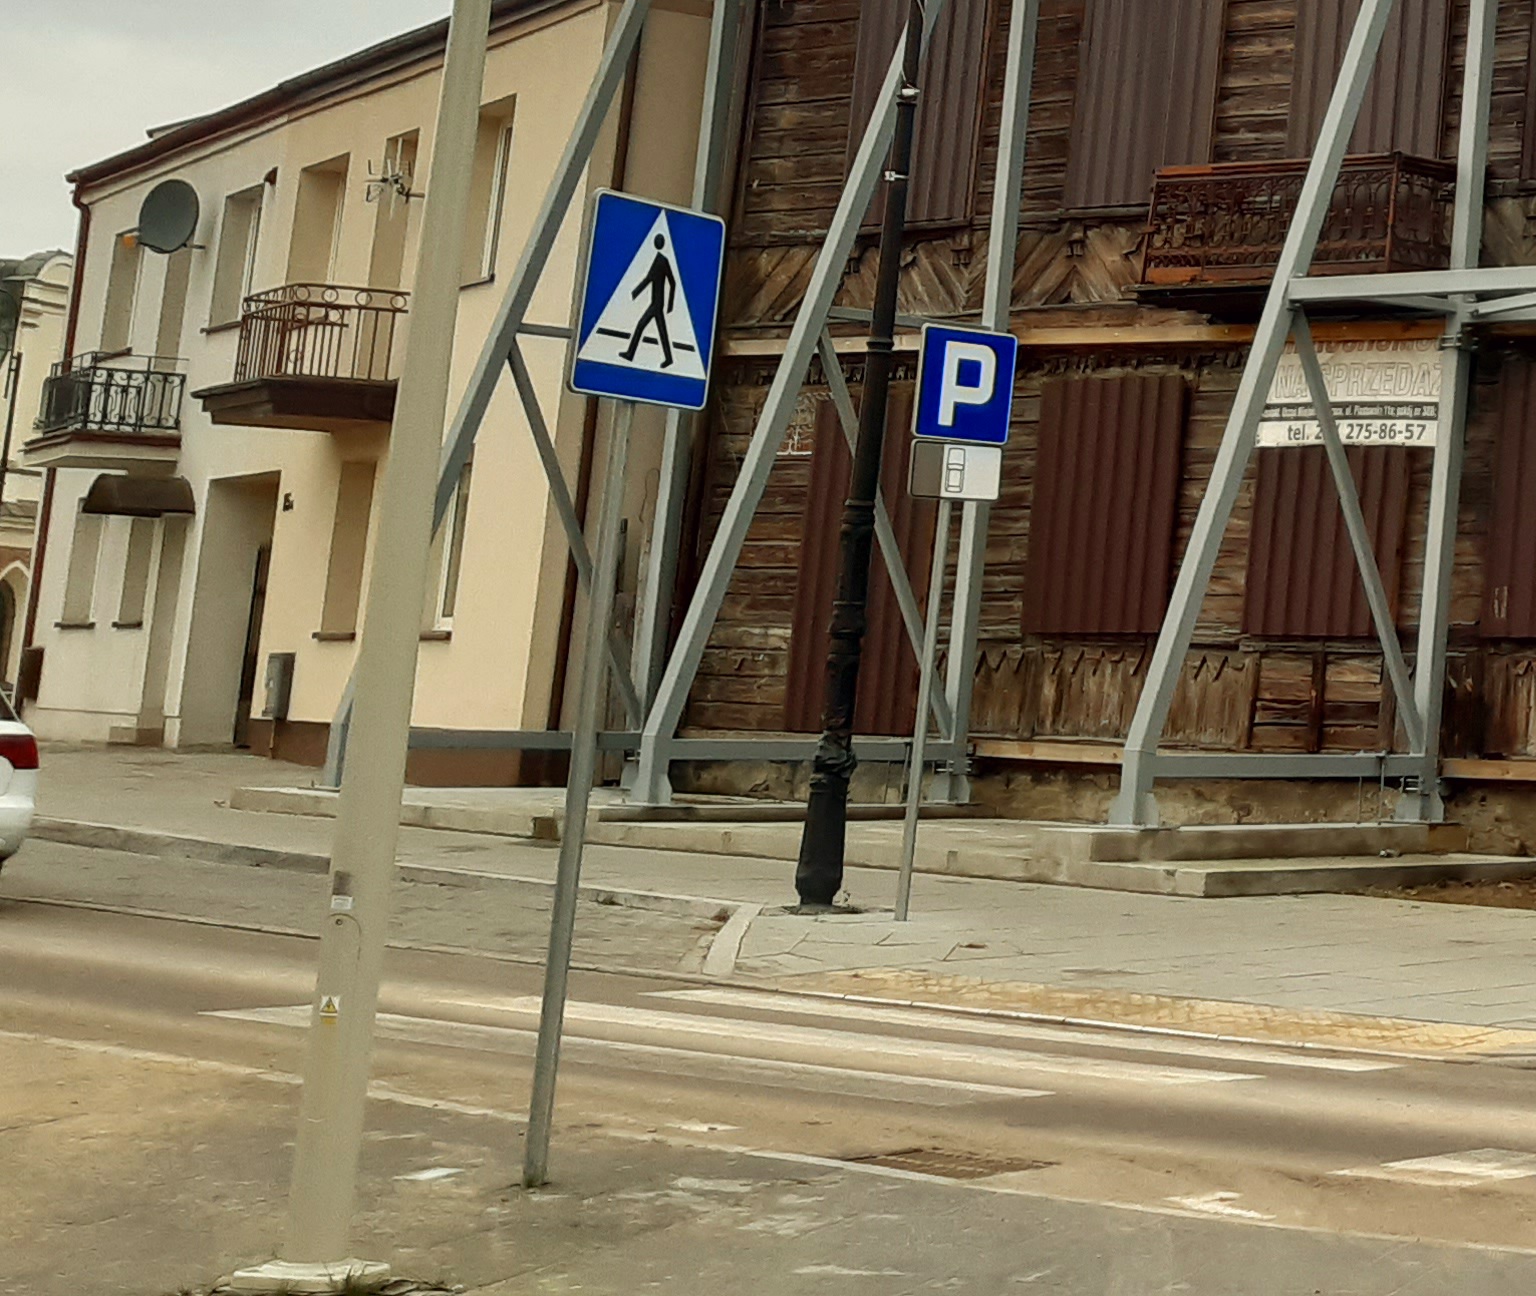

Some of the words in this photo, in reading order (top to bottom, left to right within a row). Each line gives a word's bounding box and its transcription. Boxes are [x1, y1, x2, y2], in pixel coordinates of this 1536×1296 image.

[938, 340, 996, 426] P
[1288, 425, 1310, 441] tel.
[1345, 423, 1427, 441] 275-86-57
